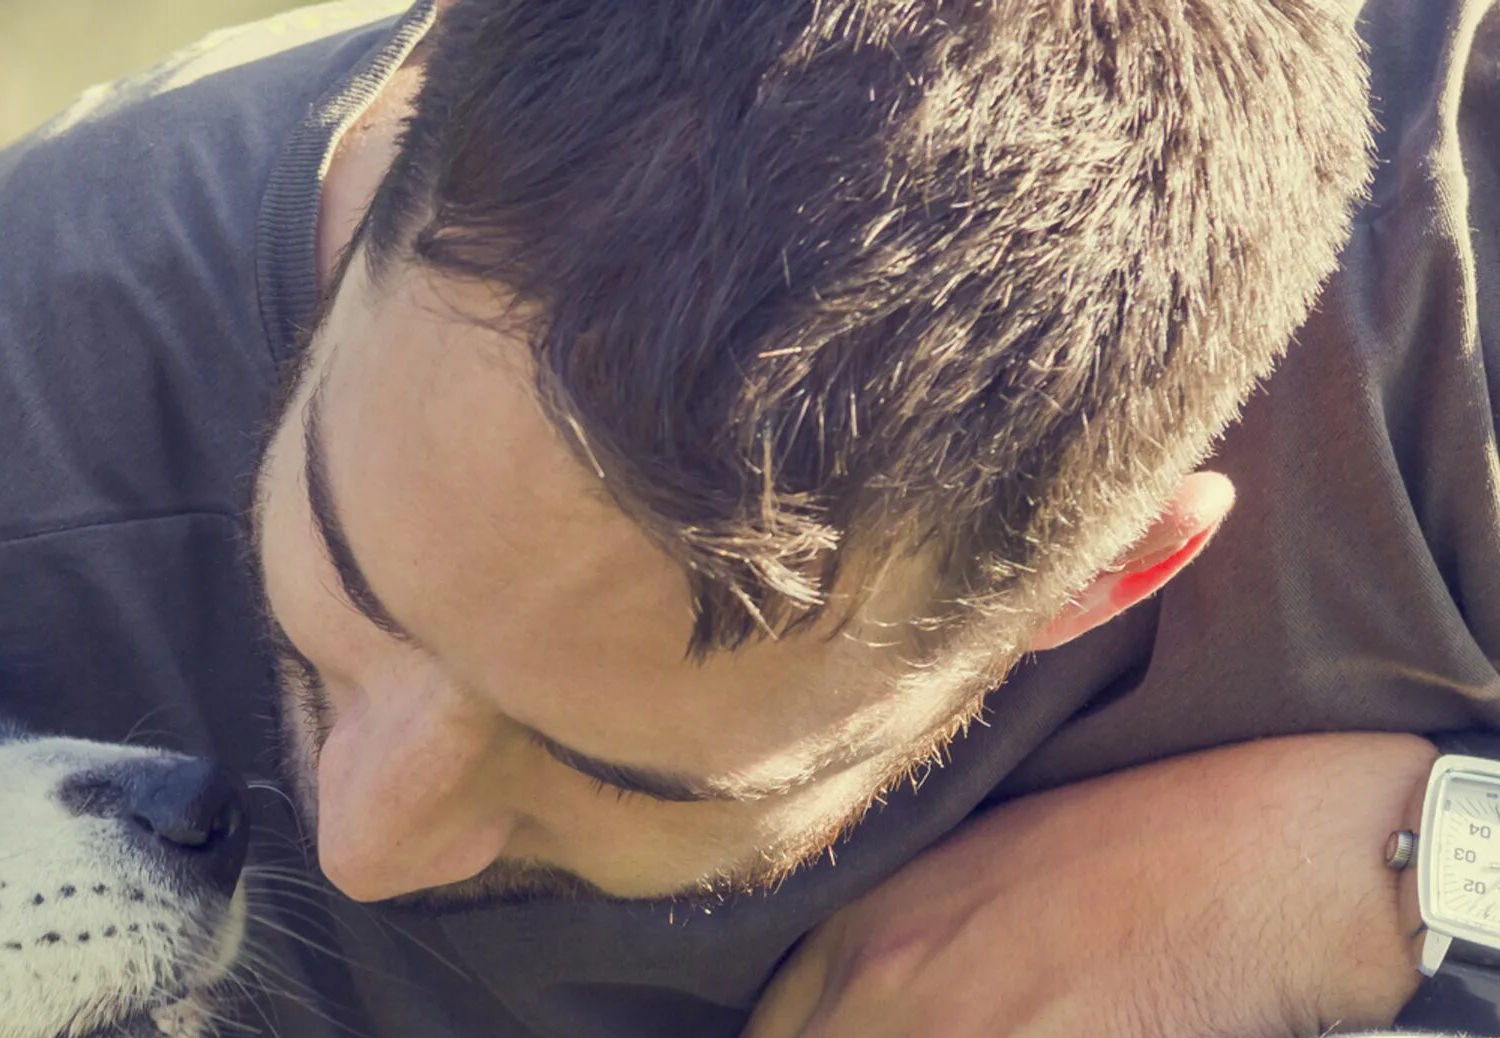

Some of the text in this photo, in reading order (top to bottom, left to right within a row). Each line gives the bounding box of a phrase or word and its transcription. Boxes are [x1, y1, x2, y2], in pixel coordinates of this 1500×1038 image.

[1469, 823, 1491, 839] 04
[1454, 848, 1476, 863] 03
[1463, 879, 1486, 895] 02
